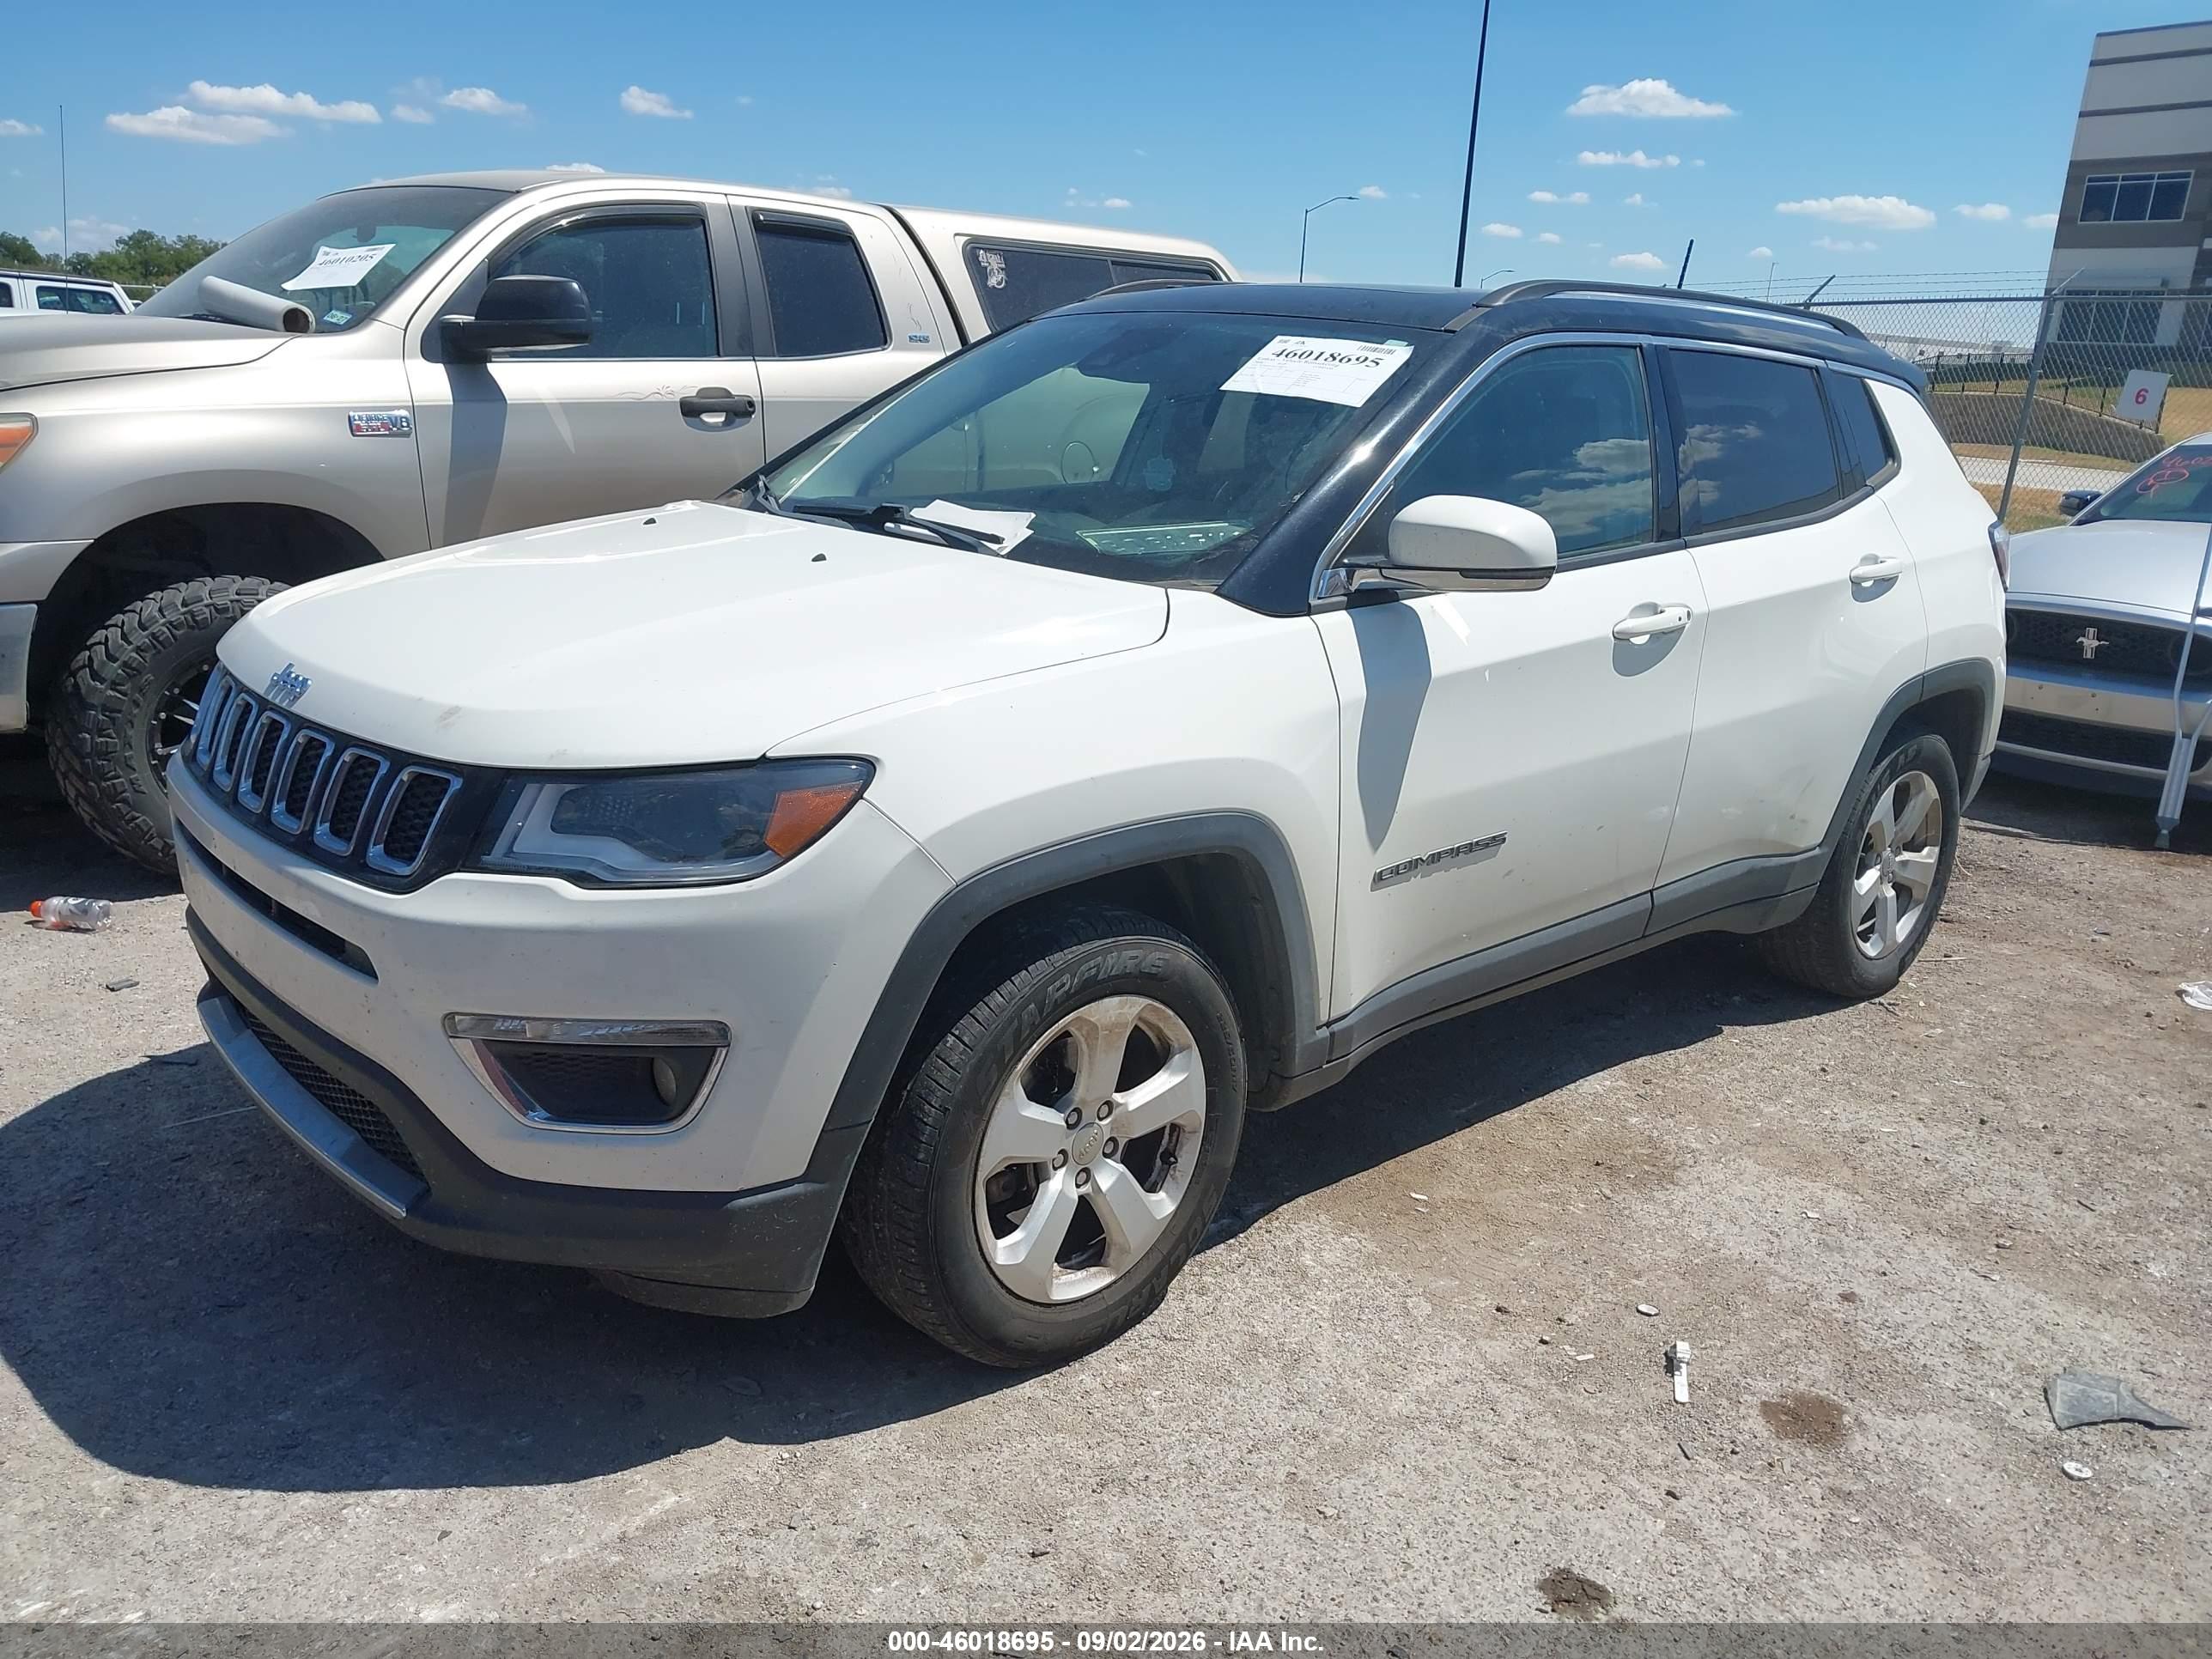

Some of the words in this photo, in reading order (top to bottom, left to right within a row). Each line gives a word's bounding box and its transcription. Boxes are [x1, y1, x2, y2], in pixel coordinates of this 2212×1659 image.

[1271, 347, 1386, 369] 46018695
[2135, 388, 2148, 404] 6
[1373, 830, 1509, 884] COMPASS
[978, 948, 1174, 1097] STARFIRE
